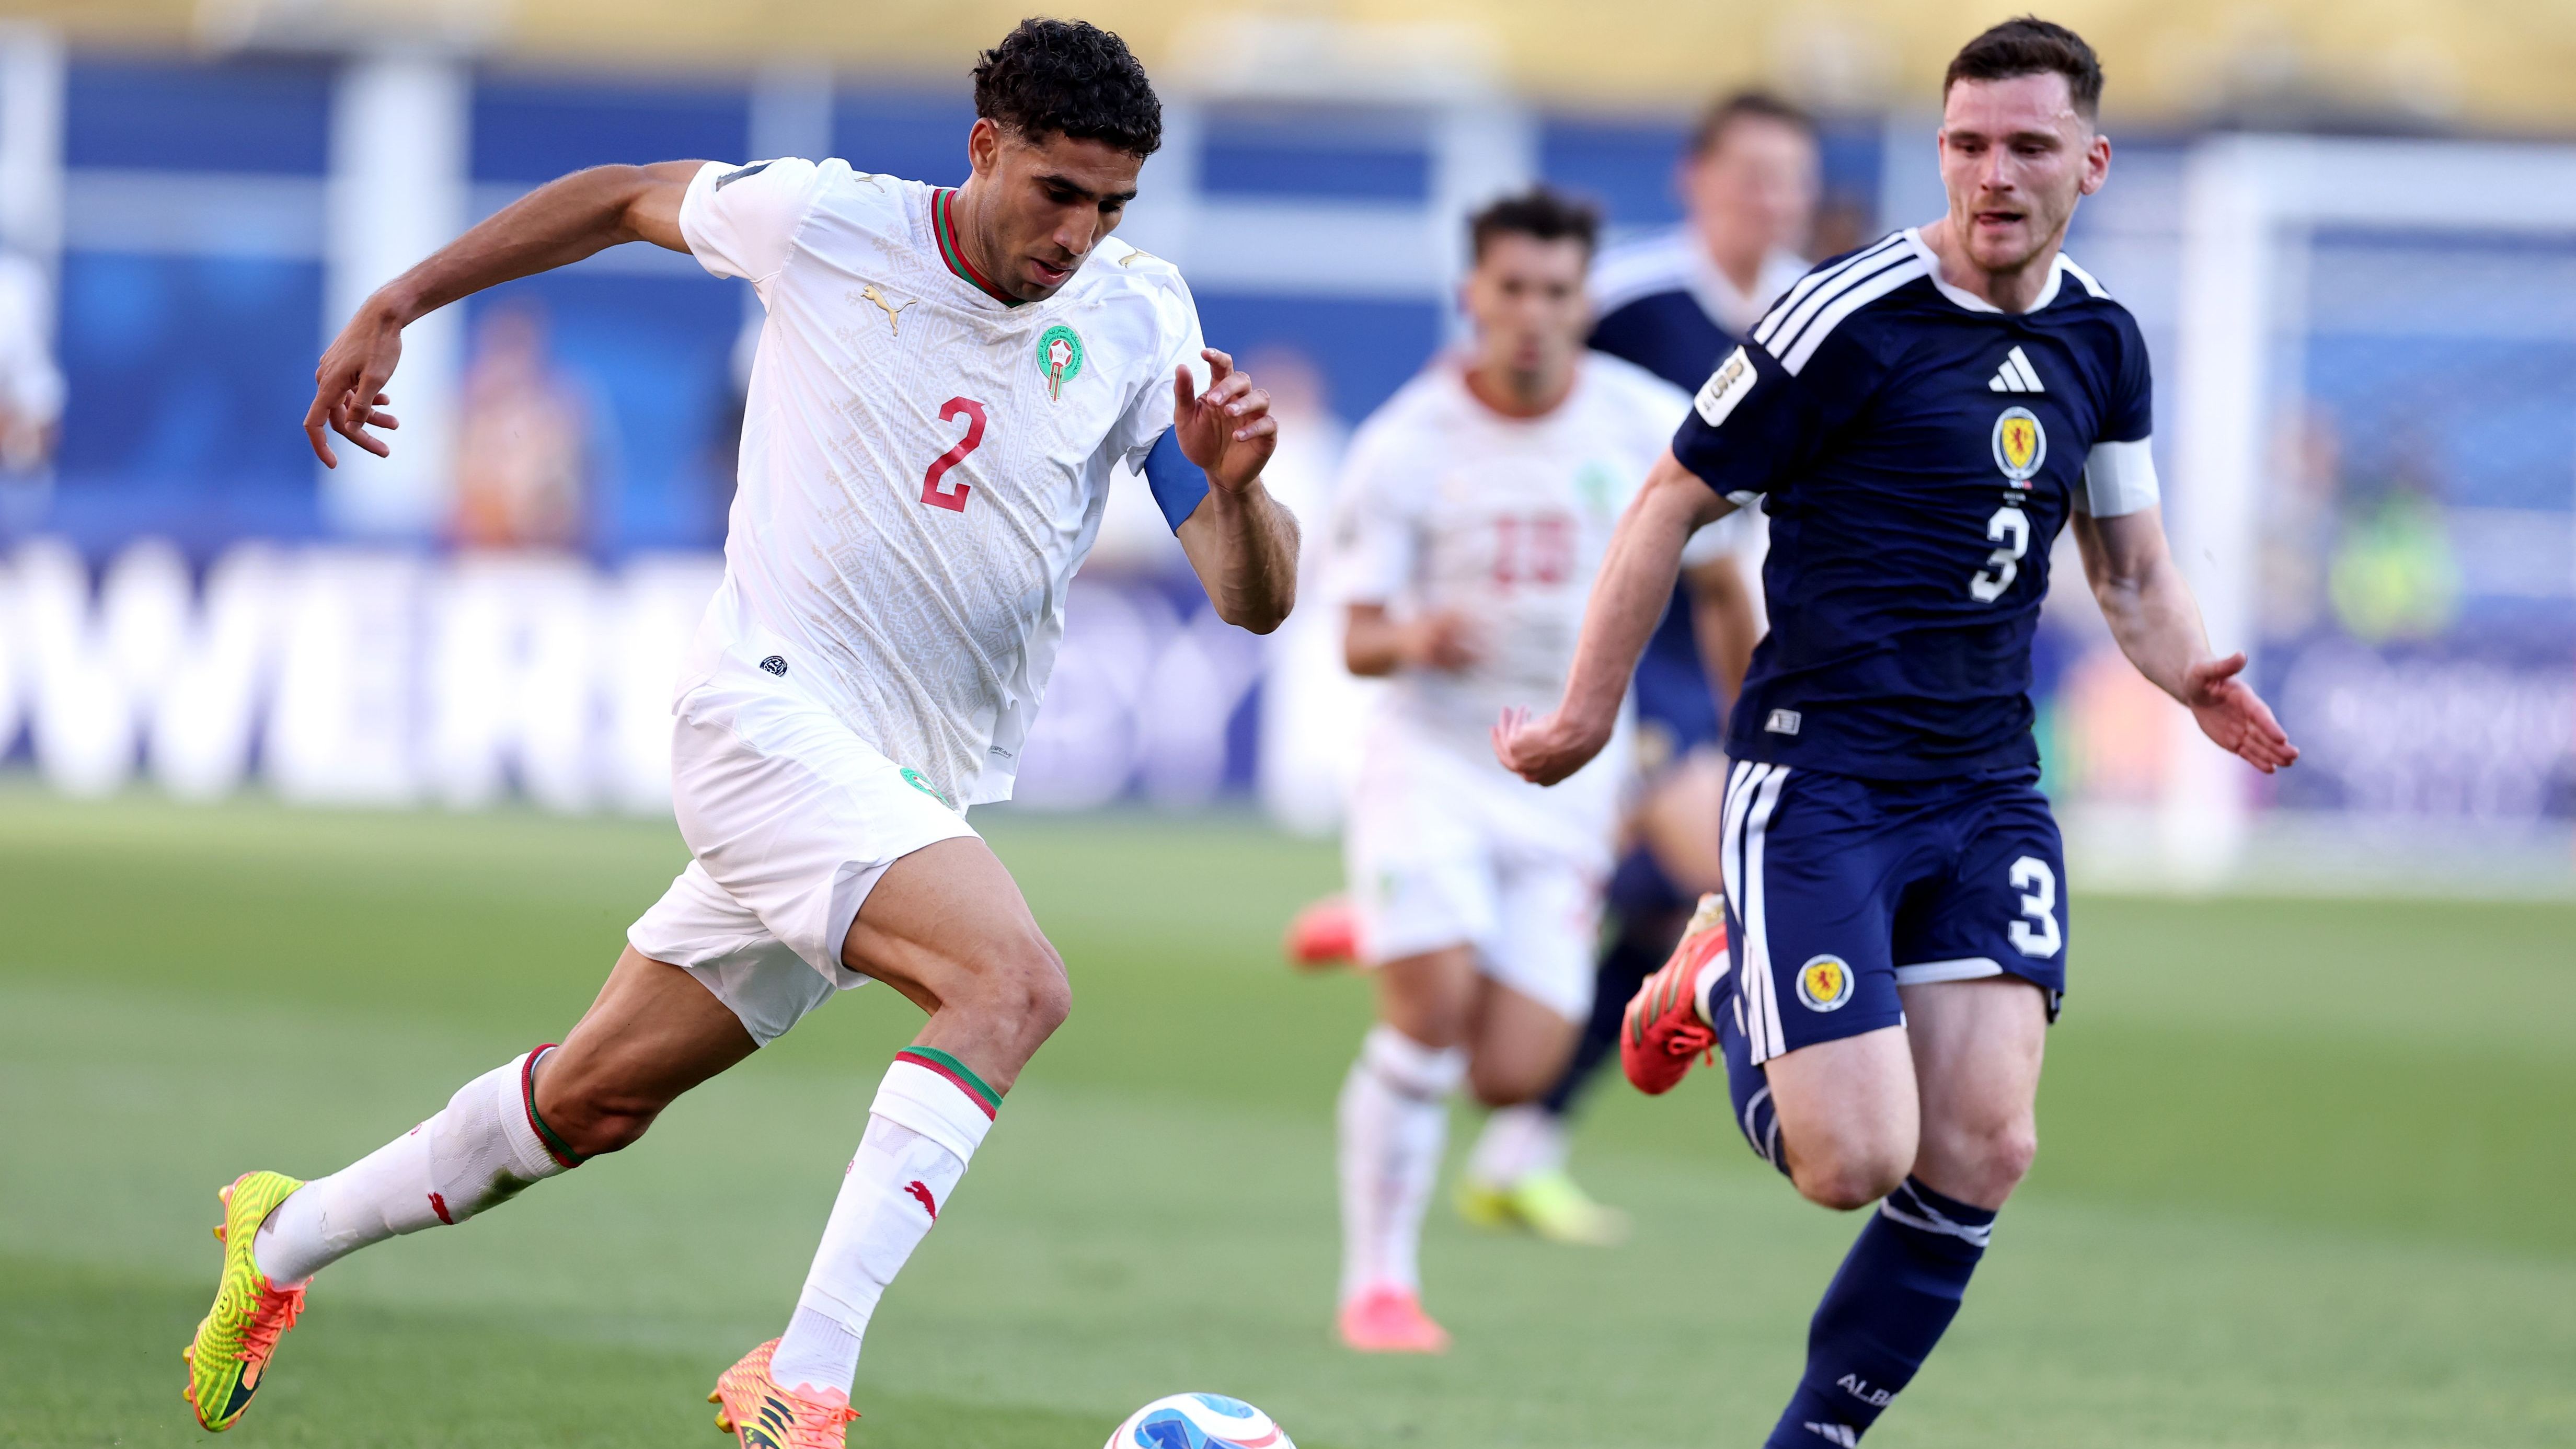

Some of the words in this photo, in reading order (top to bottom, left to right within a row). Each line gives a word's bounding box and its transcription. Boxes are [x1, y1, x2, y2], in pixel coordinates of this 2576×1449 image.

[921, 396, 987, 513] 2
[1969, 507, 2030, 603] 3
[2008, 856, 2062, 958] 3
